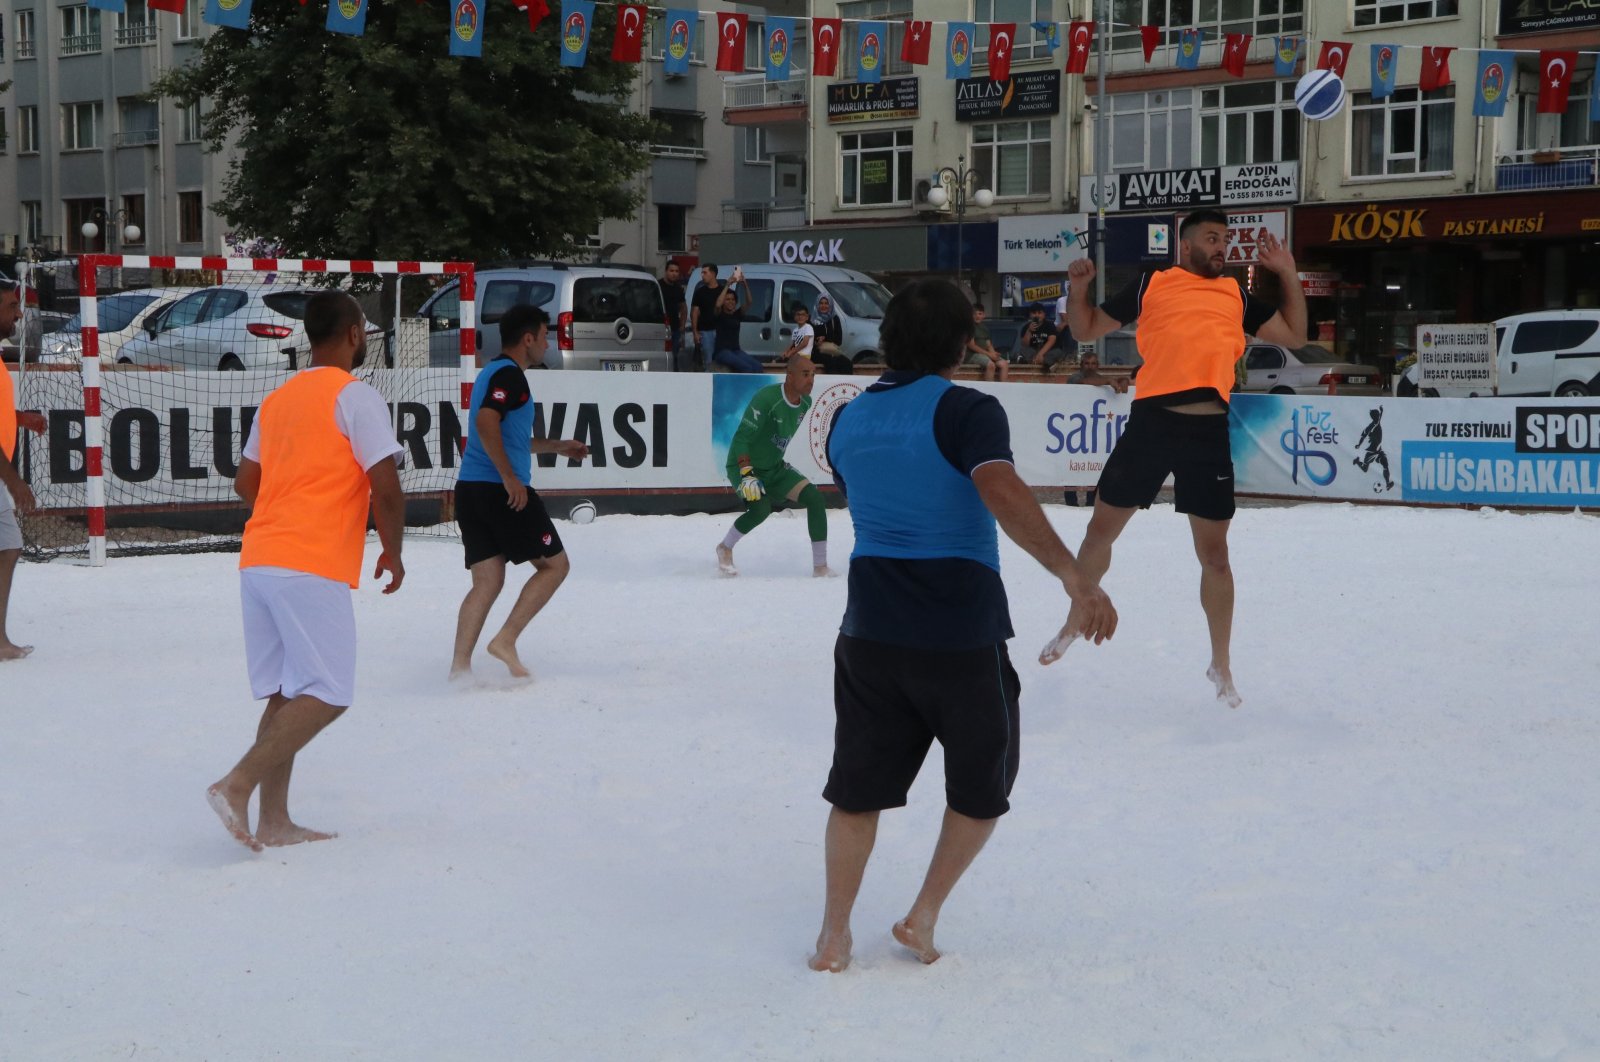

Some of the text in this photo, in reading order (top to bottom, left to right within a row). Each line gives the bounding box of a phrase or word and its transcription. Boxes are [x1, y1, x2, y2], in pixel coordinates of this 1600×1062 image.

[835, 83, 890, 101] MUFA
[957, 79, 1003, 100] ATLAS
[872, 99, 895, 110] PROJE
[958, 102, 979, 110] HUKUK
[1238, 165, 1278, 177] AYDIN
[1125, 169, 1216, 198] AVUKAT
[1225, 175, 1291, 190] ERDOĞAN
[1146, 194, 1190, 205] KAT:1 NO:2
[1237, 191, 1250, 199] 555
[1251, 190, 1264, 198] 876
[1274, 189, 1284, 197] 45
[1228, 214, 1263, 224] KIRI
[1329, 204, 1544, 243] KÖŞK PASTANESİ
[1004, 238, 1062, 250] Türk Telekom
[1045, 398, 1128, 454] safir
[1425, 422, 1448, 438] TUZ
[1450, 420, 1512, 439] FESTİVALİ
